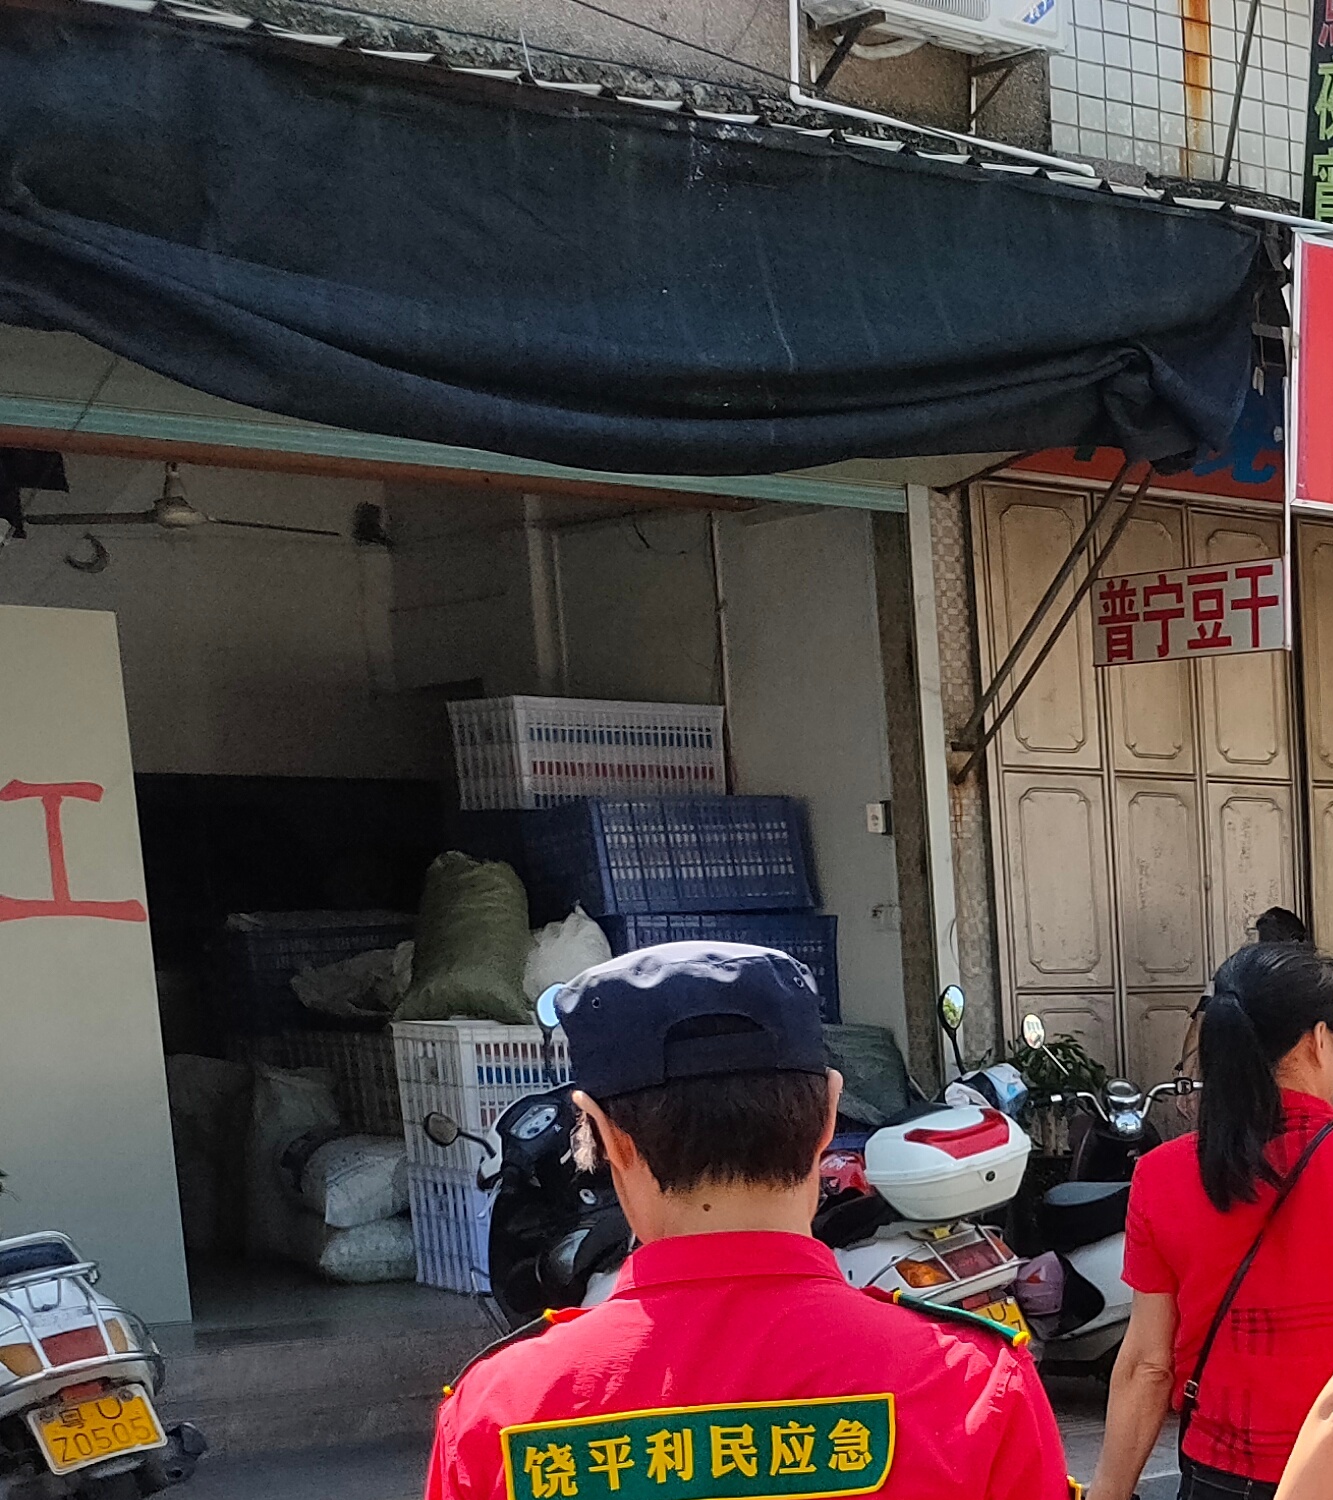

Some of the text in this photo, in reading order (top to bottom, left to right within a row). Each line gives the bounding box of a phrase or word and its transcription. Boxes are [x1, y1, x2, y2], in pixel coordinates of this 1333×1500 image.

[1099, 565, 1279, 662] 普宁豆干
[522, 1417, 875, 1499] 饶平利民应急
